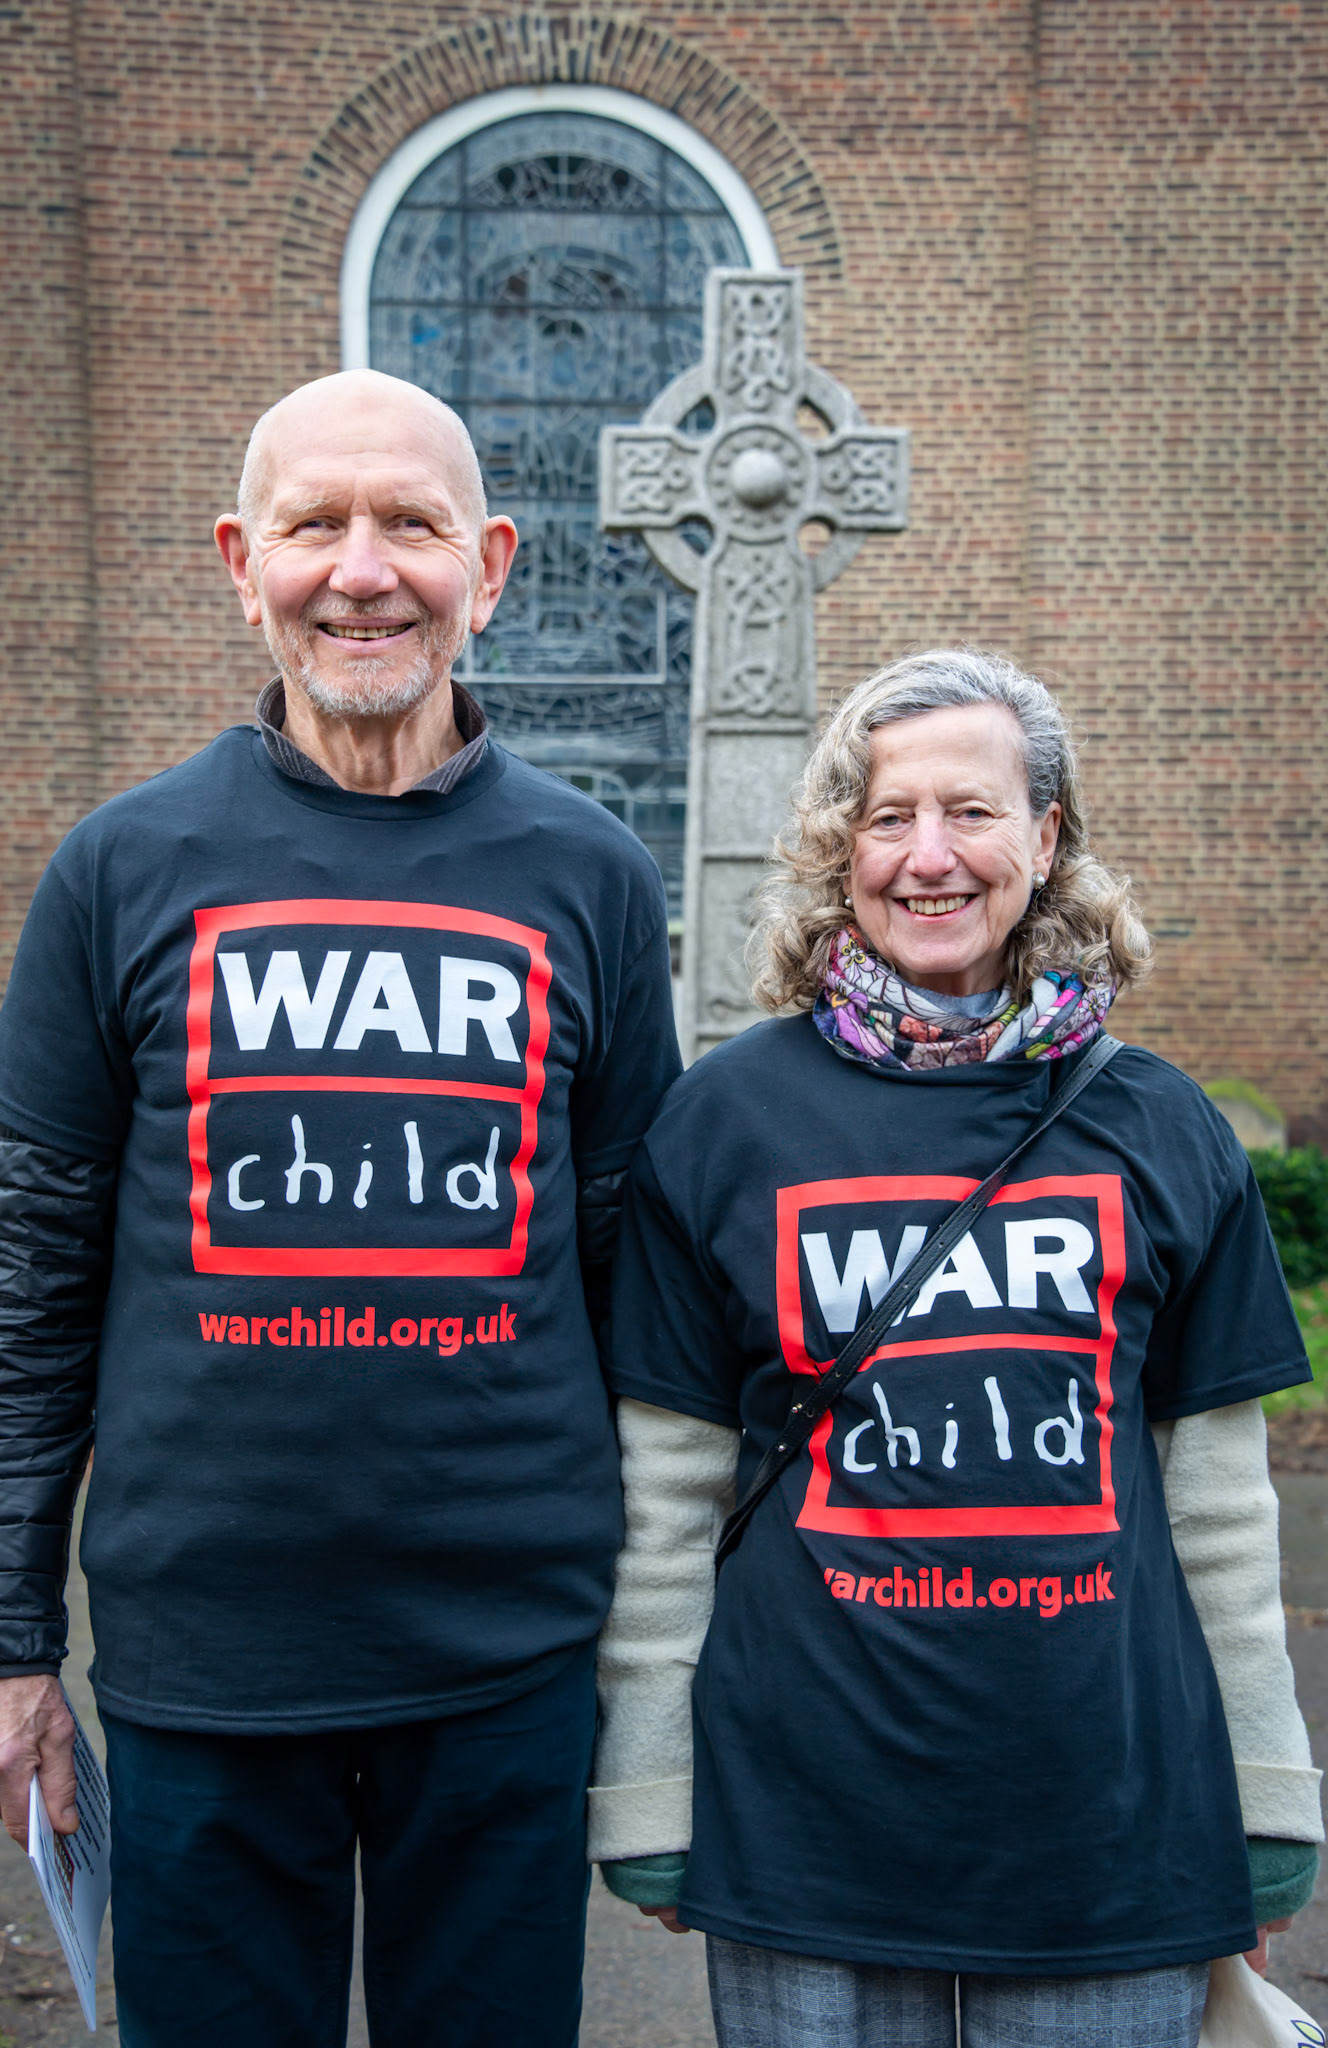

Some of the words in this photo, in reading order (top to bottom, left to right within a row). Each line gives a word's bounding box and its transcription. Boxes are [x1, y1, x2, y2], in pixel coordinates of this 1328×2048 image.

[217, 950, 522, 1063] WAR
[227, 1114, 500, 1211] child
[800, 1217, 1096, 1333] WAR
[198, 1303, 518, 1357] warchild.org.uk
[842, 1376, 1085, 1473] child
[823, 1561, 1116, 1618] archild.org.uk
